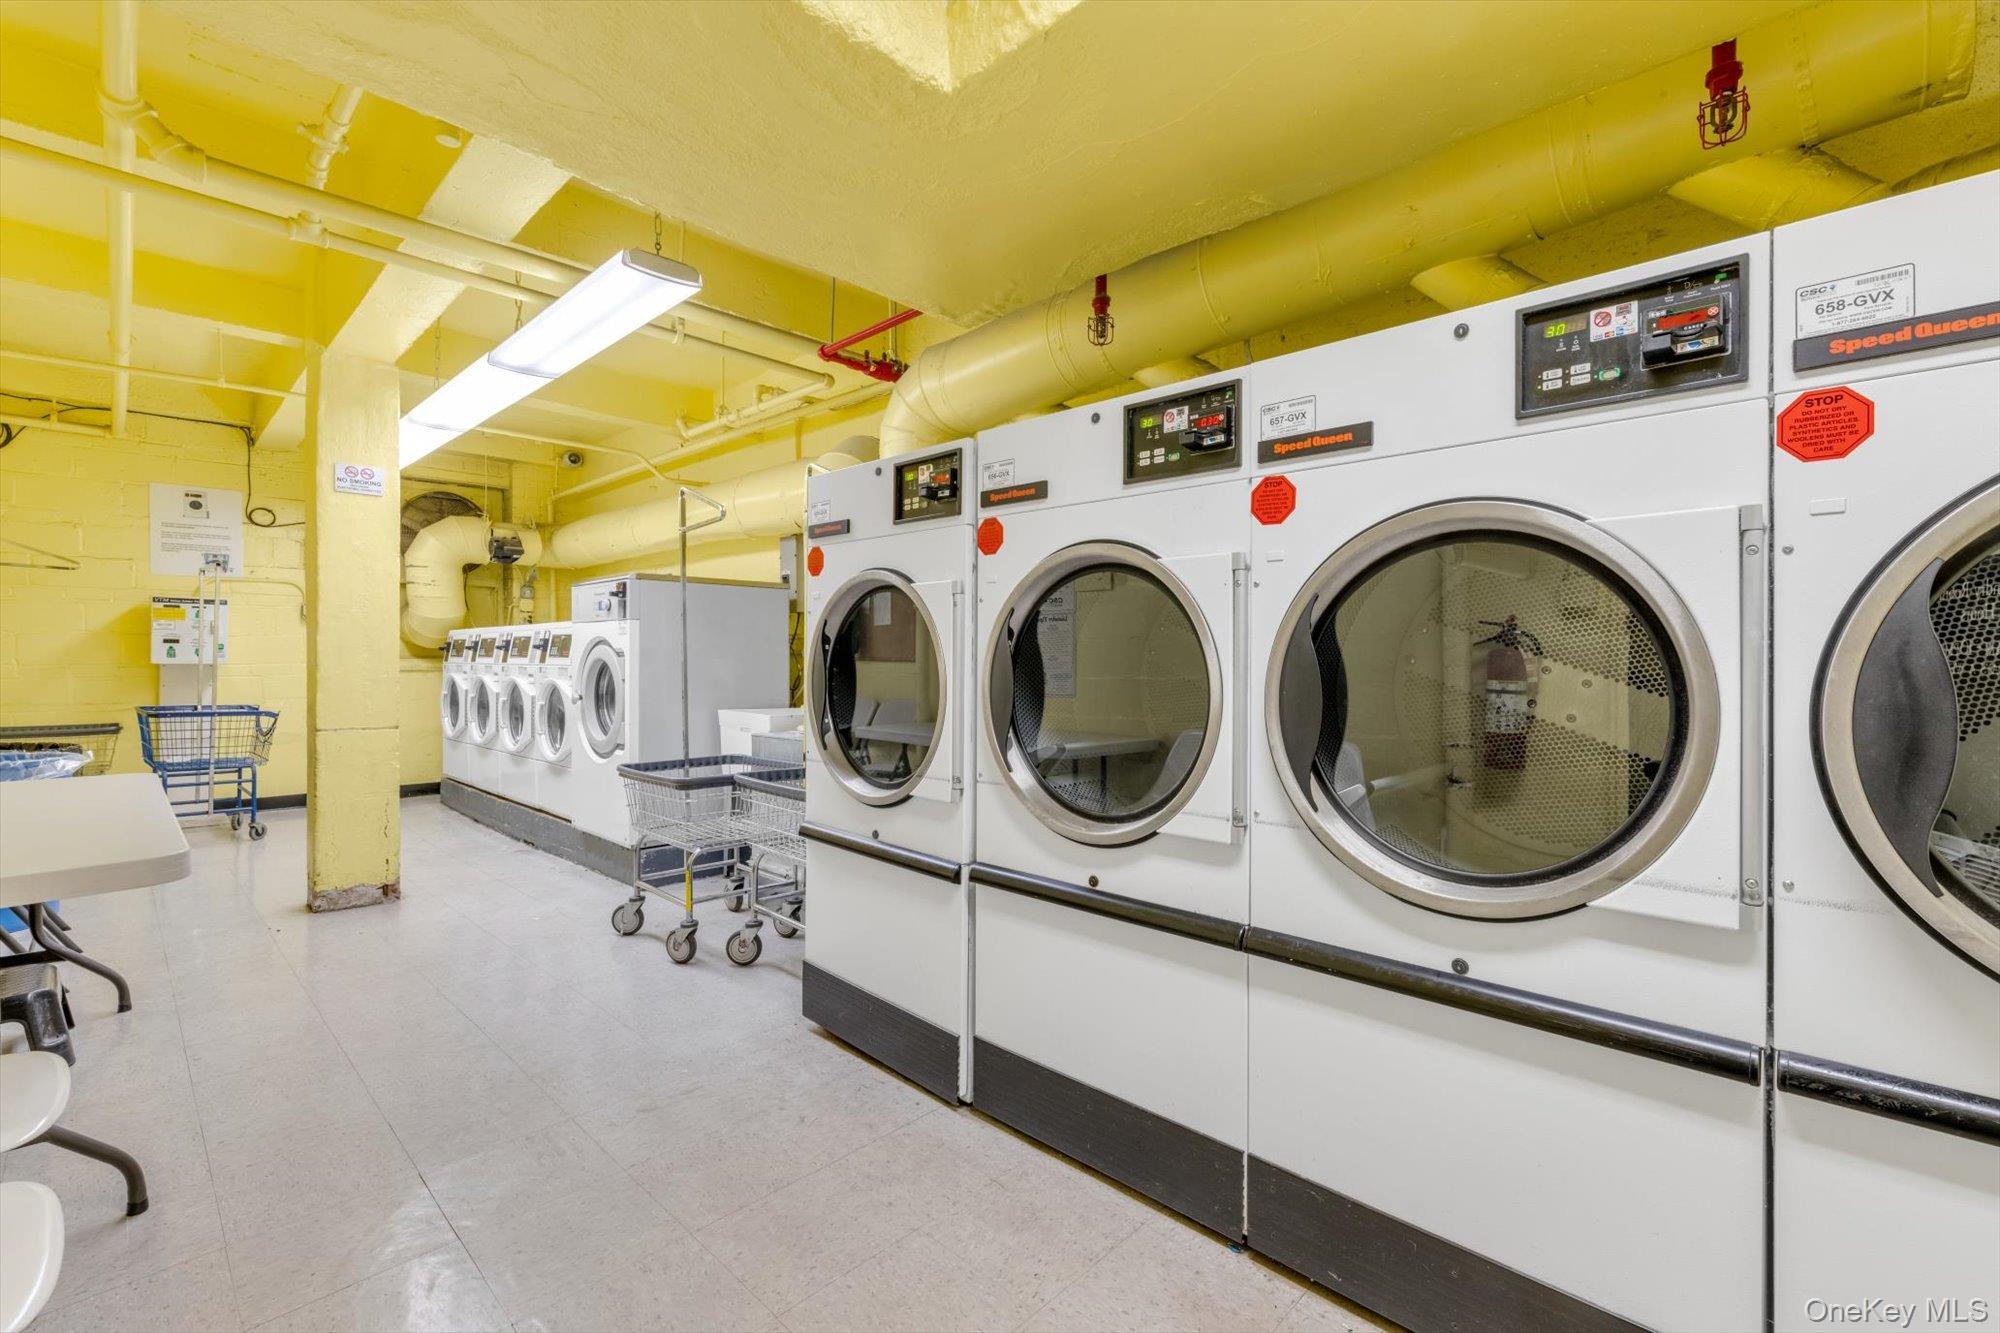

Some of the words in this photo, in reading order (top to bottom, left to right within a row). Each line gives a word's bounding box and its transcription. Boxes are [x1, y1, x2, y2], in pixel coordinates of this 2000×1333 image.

[1800, 286, 1827, 297] CSC
[1815, 288, 1895, 315] 658-GVX
[1545, 323, 1565, 338] 30
[1829, 325, 1911, 354] Speed
[1914, 312, 2000, 338] Queen
[1805, 395, 1844, 408] STOP
[1142, 418, 1153, 428] 30
[1270, 411, 1307, 425] 657-GVX
[1790, 422, 1819, 430] PLASTIC
[1821, 417, 1858, 426] ARTICLES
[1794, 413, 1841, 423] RUBBERIZED
[1793, 426, 1838, 436] SYNTHETICS
[1274, 437, 1311, 454] Speed
[1312, 432, 1353, 446] Queen
[350, 478, 382, 487] SMOKING
